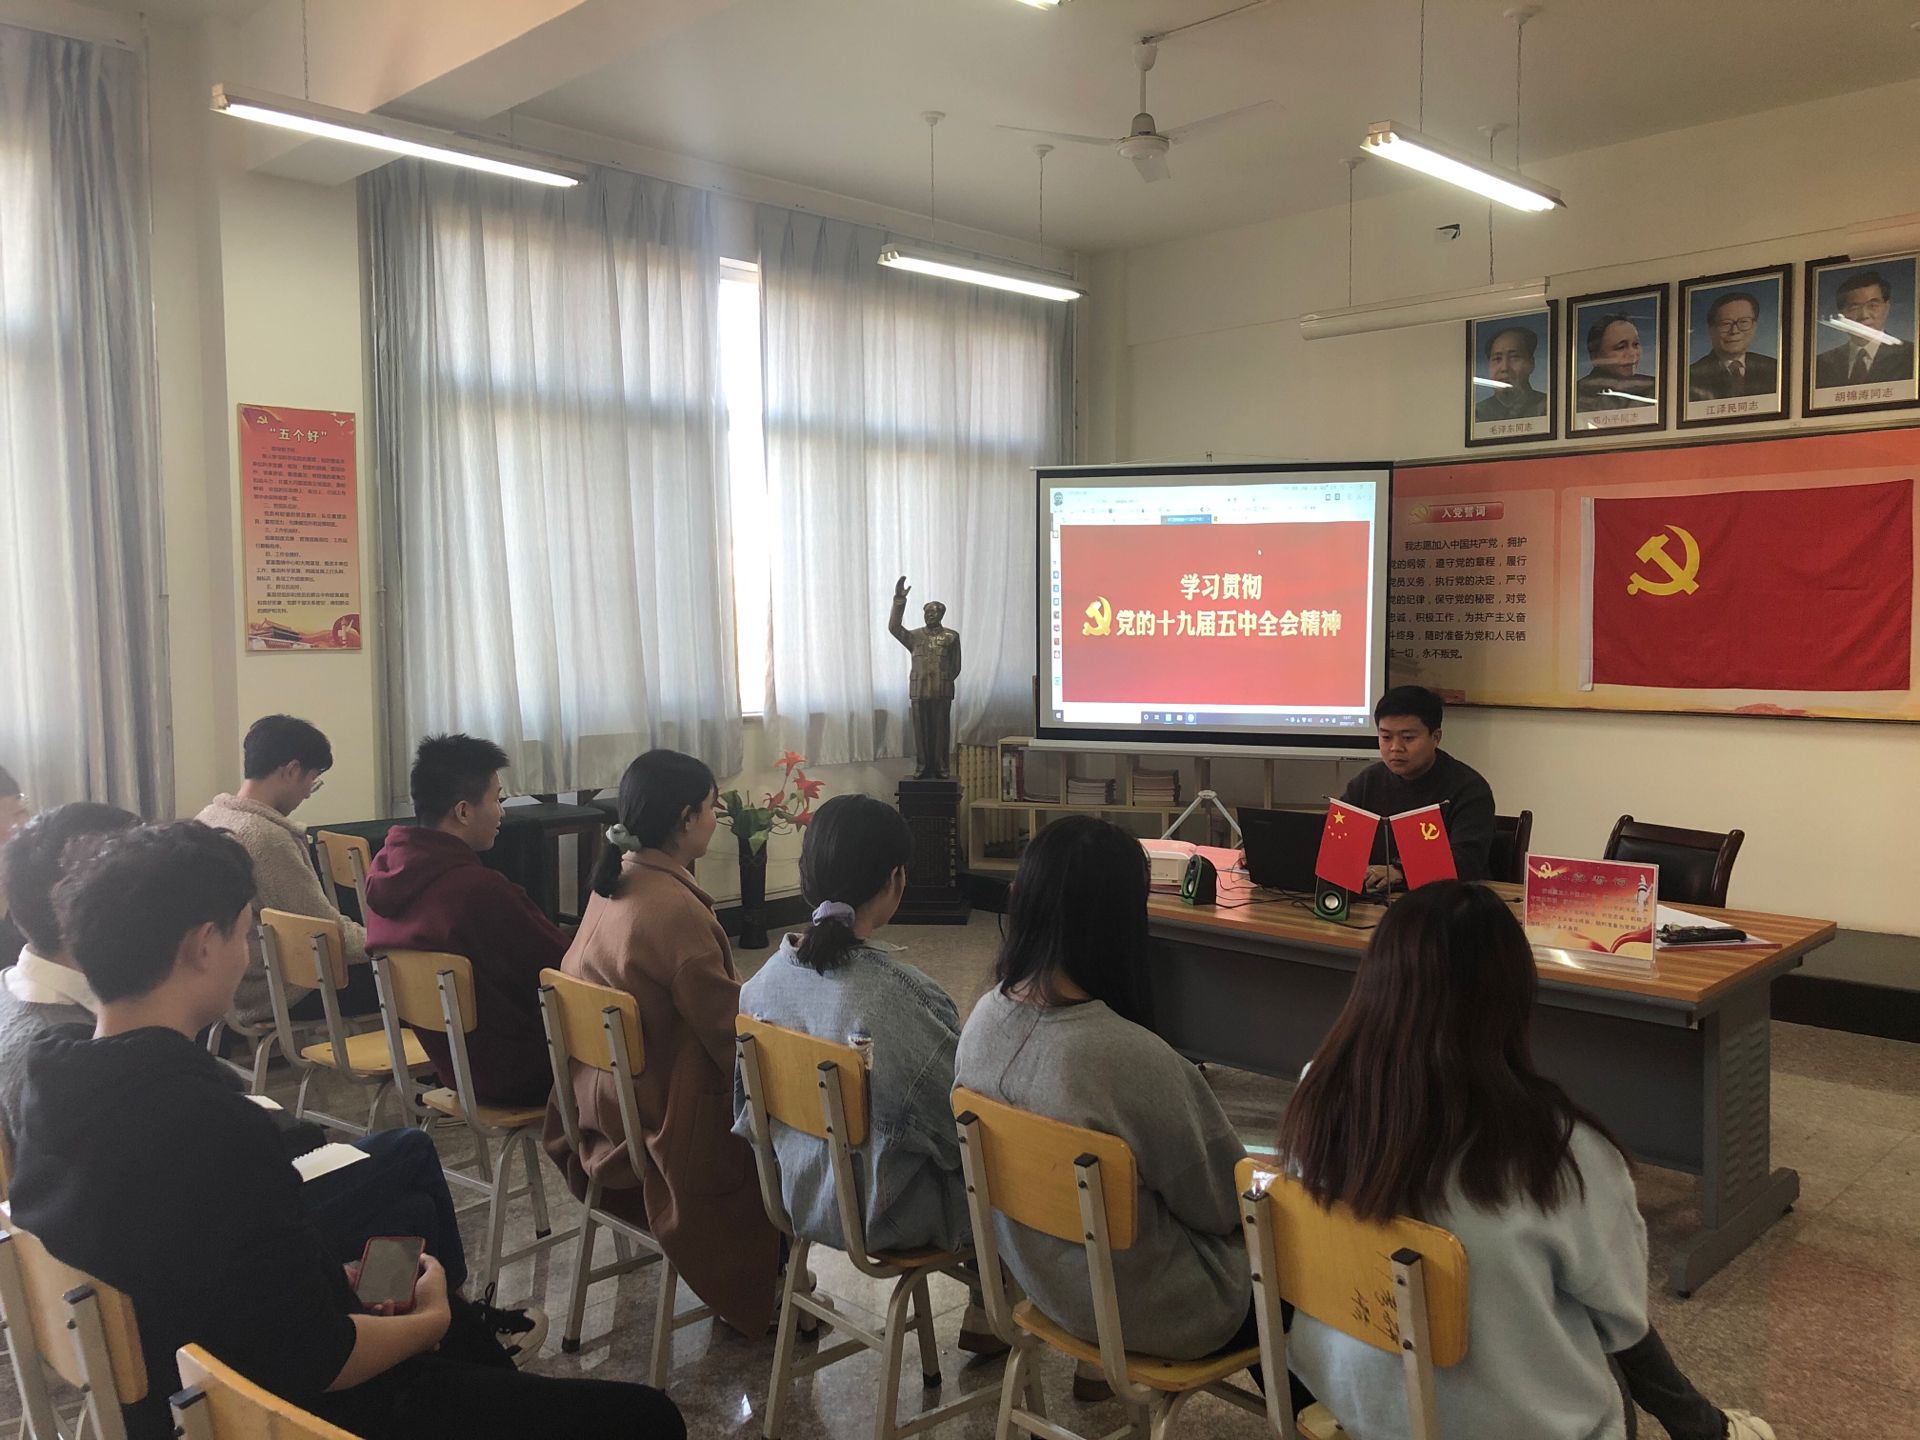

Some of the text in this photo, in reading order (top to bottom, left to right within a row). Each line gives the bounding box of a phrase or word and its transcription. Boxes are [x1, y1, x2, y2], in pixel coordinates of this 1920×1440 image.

[1834, 387, 1894, 402] 胡锦涛同志
[1706, 400, 1759, 415] 江泽民同志
[1489, 422, 1534, 434] 毛泽东同志
[1441, 506, 1486, 518] 入党誓词
[1180, 573, 1263, 601] 学习贯彻
[1115, 610, 1342, 637] 党的十九届五中全会精神
